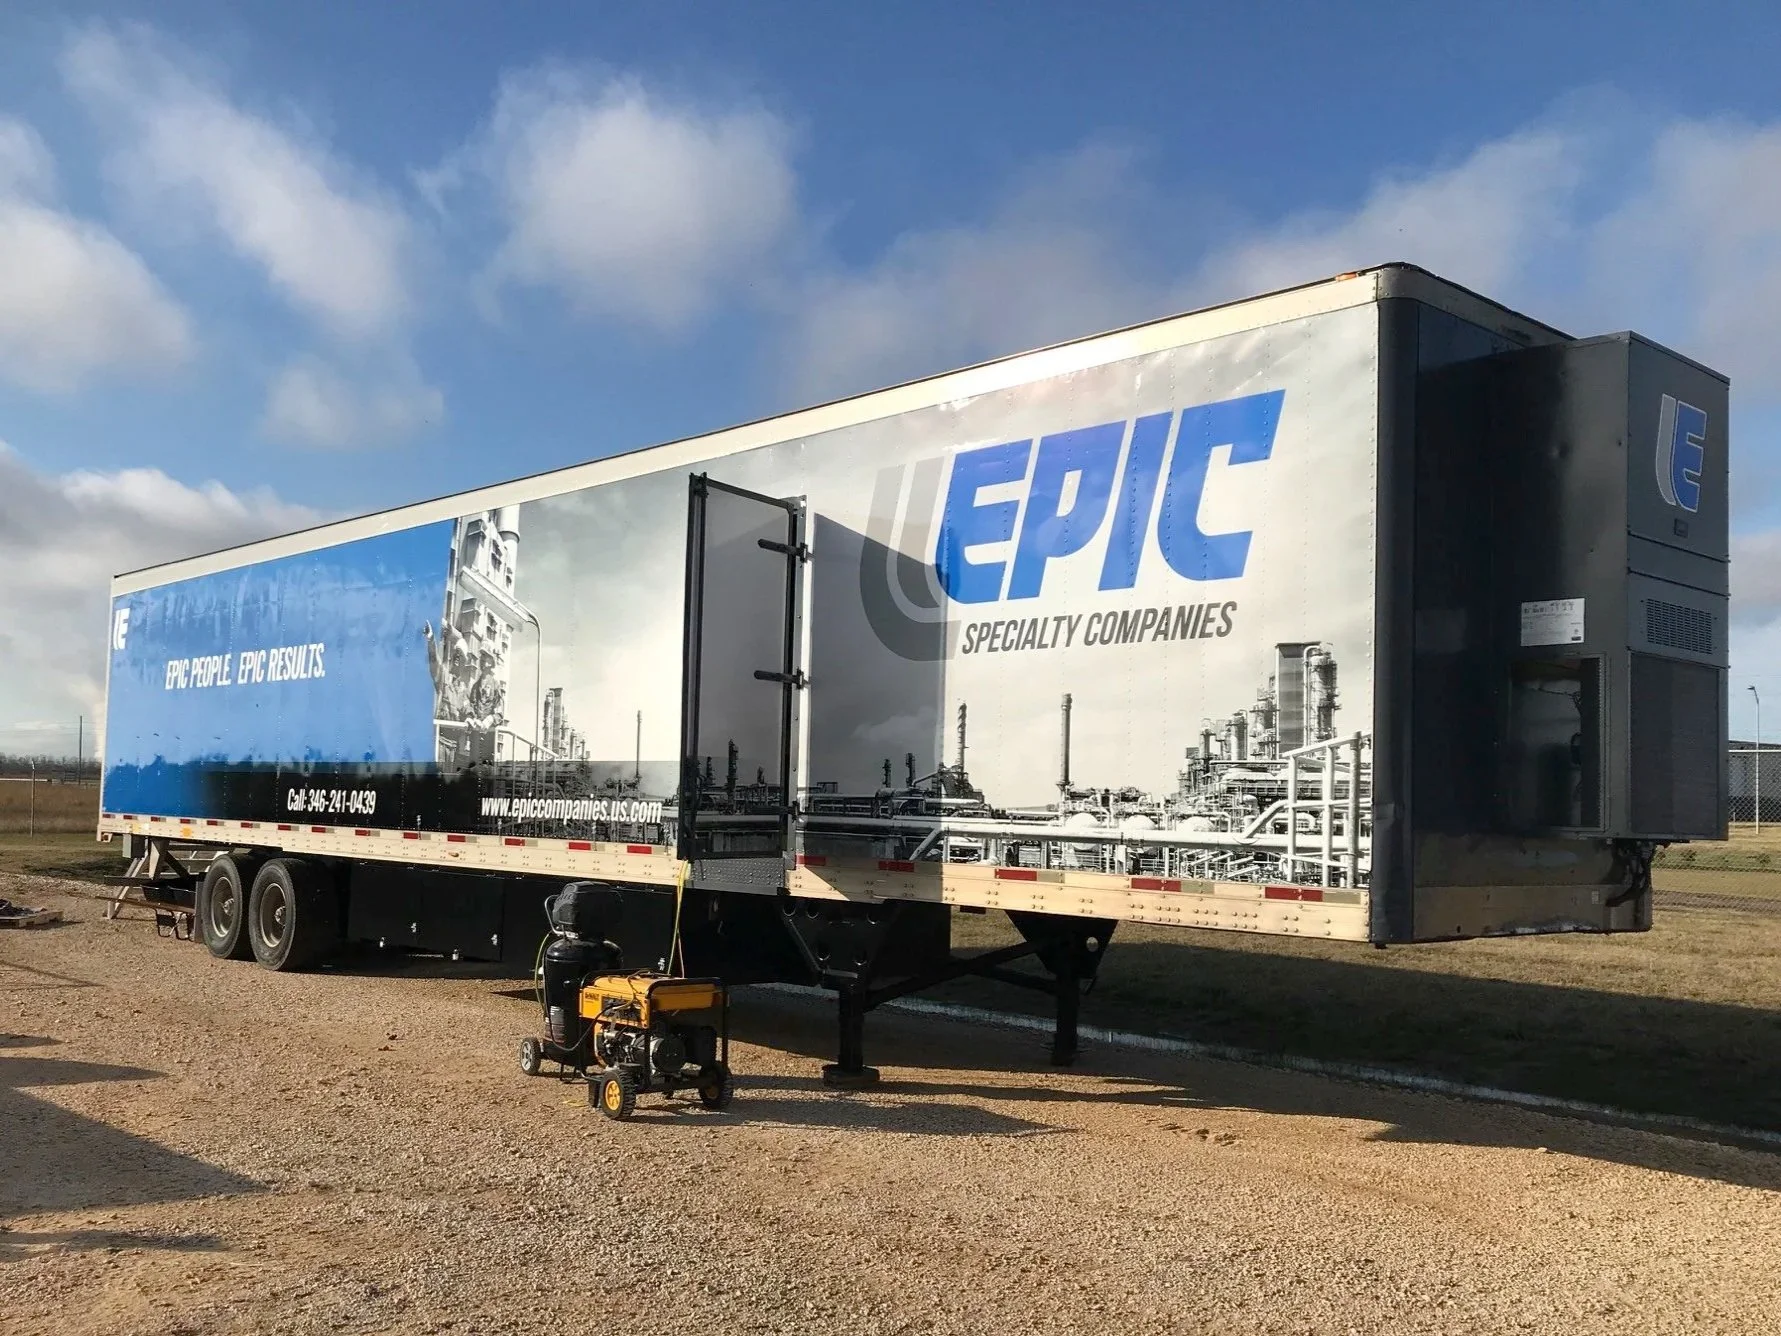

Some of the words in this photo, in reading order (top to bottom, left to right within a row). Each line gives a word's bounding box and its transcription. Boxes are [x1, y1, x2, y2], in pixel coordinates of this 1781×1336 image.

[936, 389, 1286, 604] EPIC
[962, 614, 1083, 655] SPECIALTY
[1084, 600, 1238, 646] COMPANIES
[165, 660, 189, 690] EPIC
[237, 649, 267, 684] EPIC
[267, 642, 326, 682] RESULTS.
[481, 792, 663, 826] www.epiccompanies.us.com
